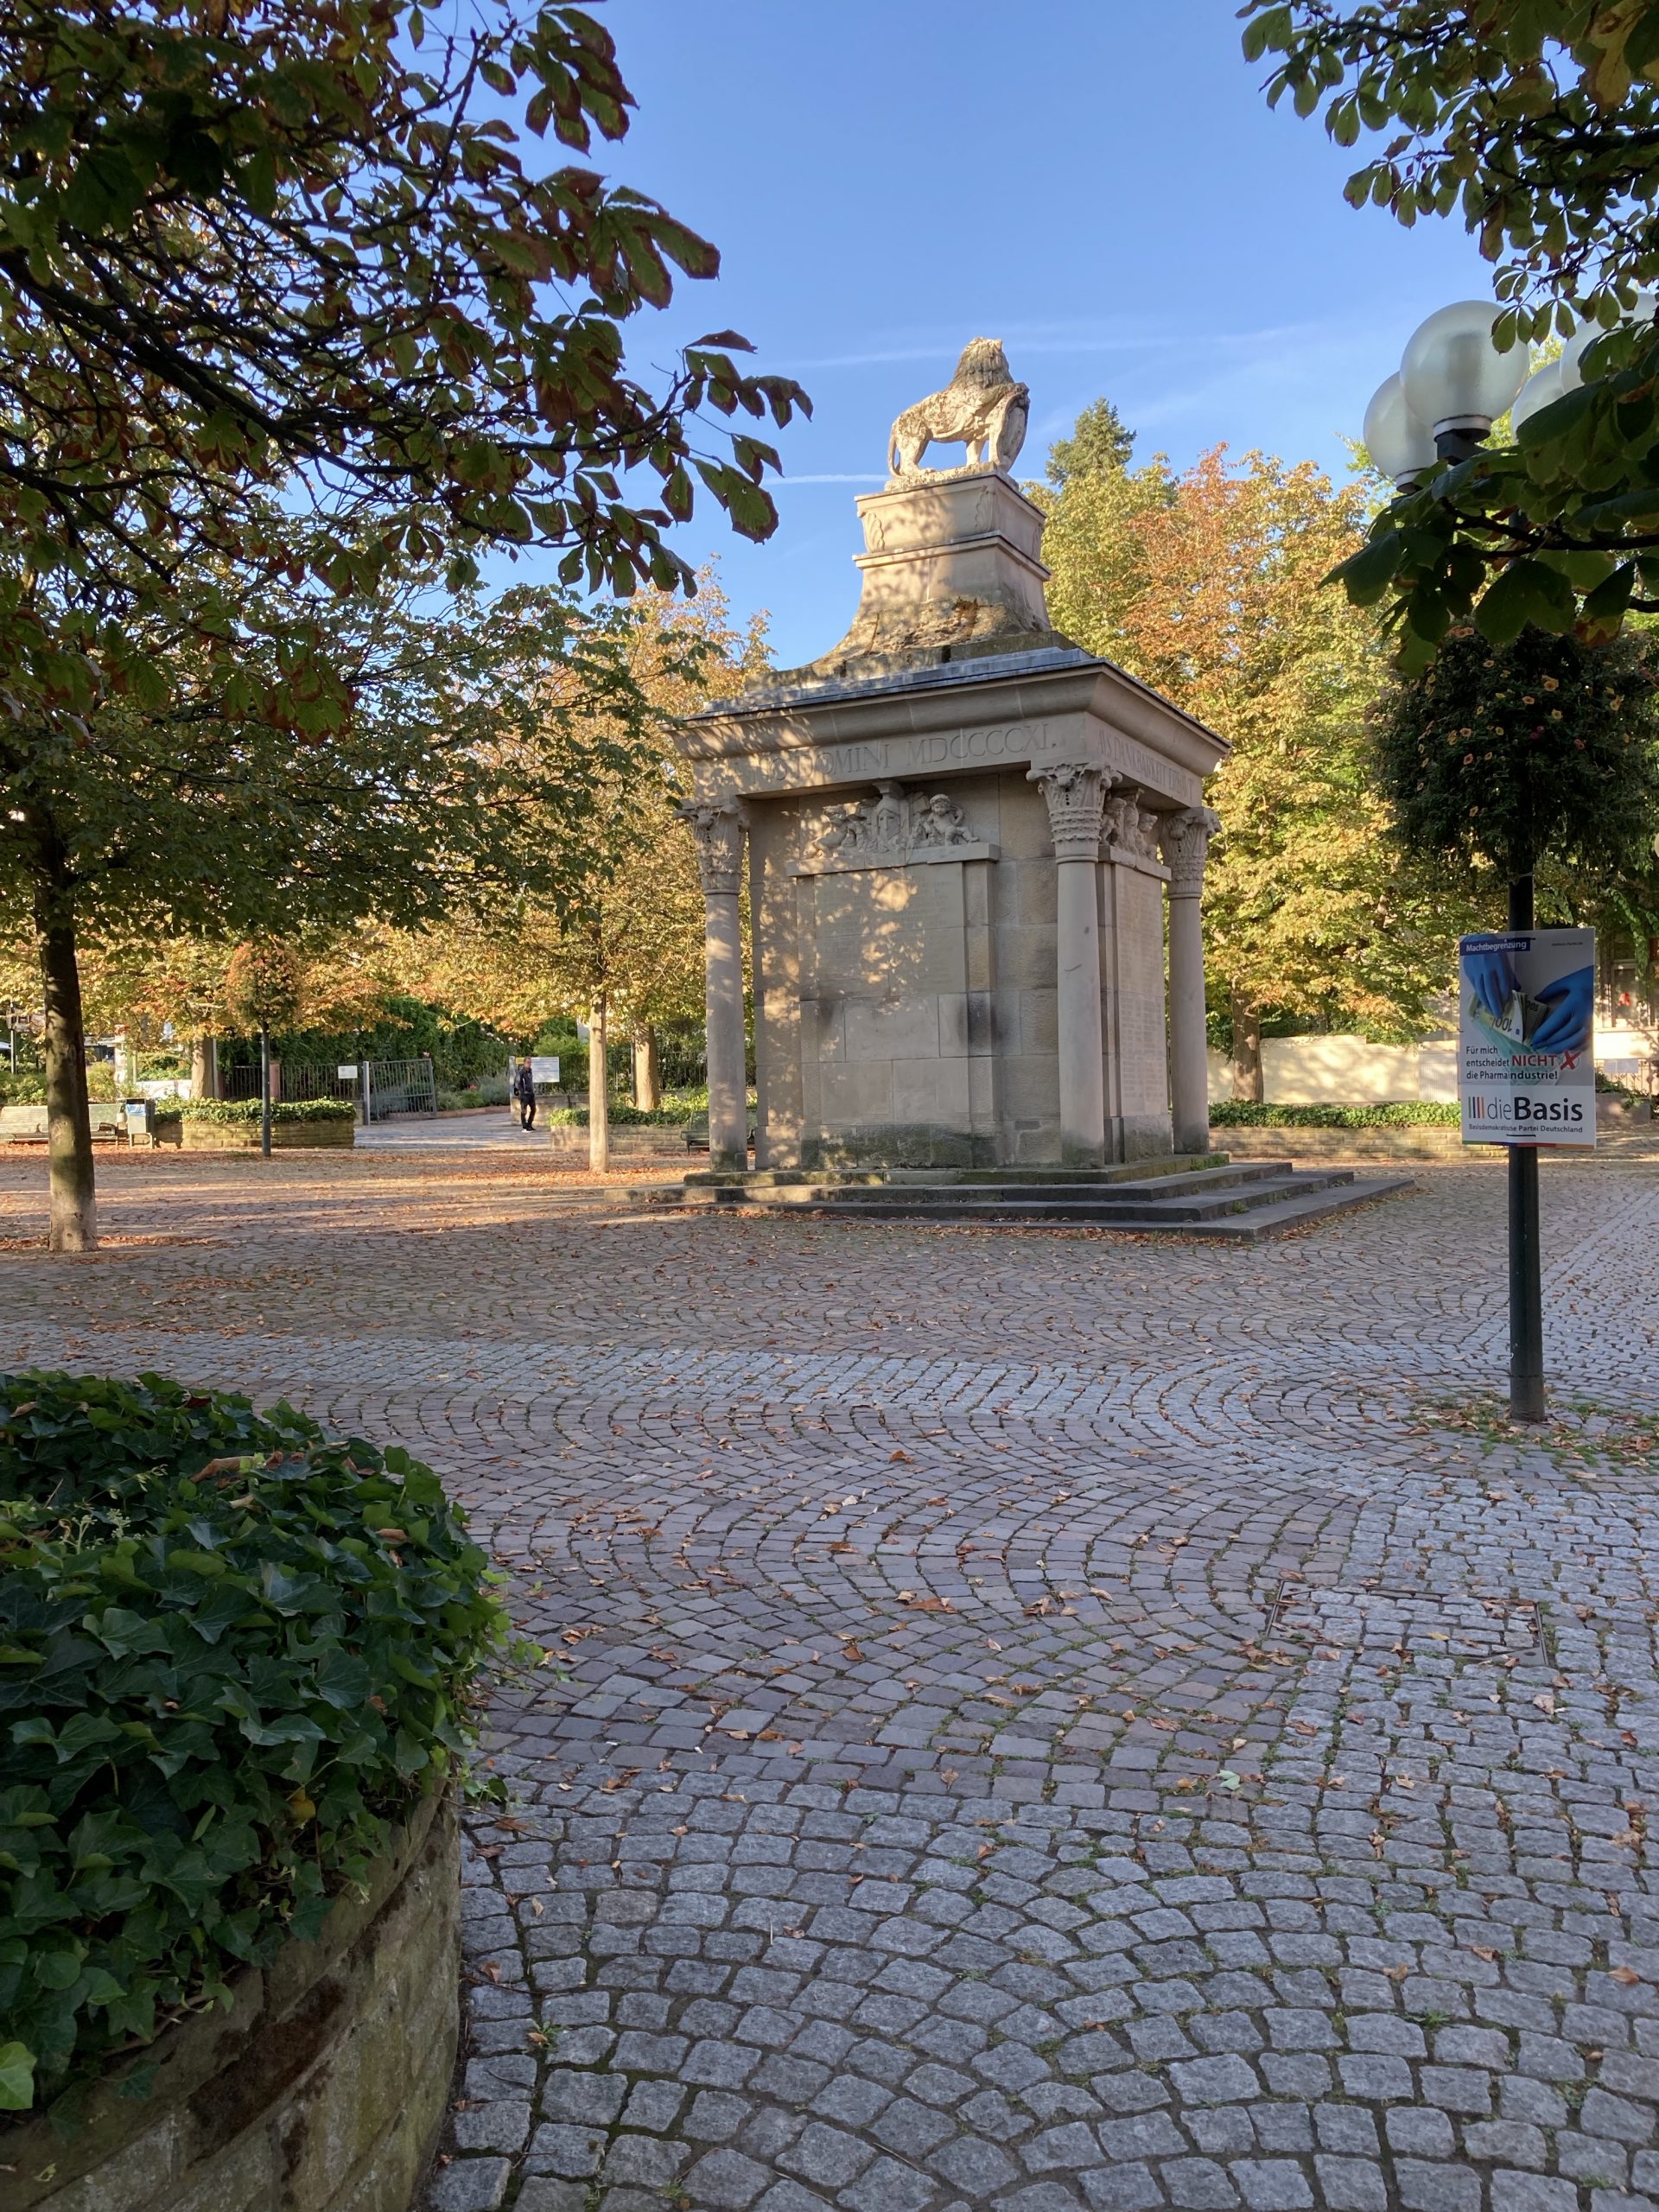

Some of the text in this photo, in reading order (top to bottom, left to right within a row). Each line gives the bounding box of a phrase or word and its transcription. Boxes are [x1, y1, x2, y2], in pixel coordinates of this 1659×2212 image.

[1465, 940, 1527, 952] Machtbegrenzung
[1465, 1046, 1498, 1055] Für mich
[1465, 1054, 1557, 1067] entscheidet NICHT
[1466, 1071, 1558, 1080] die Pharmaindustrie!
